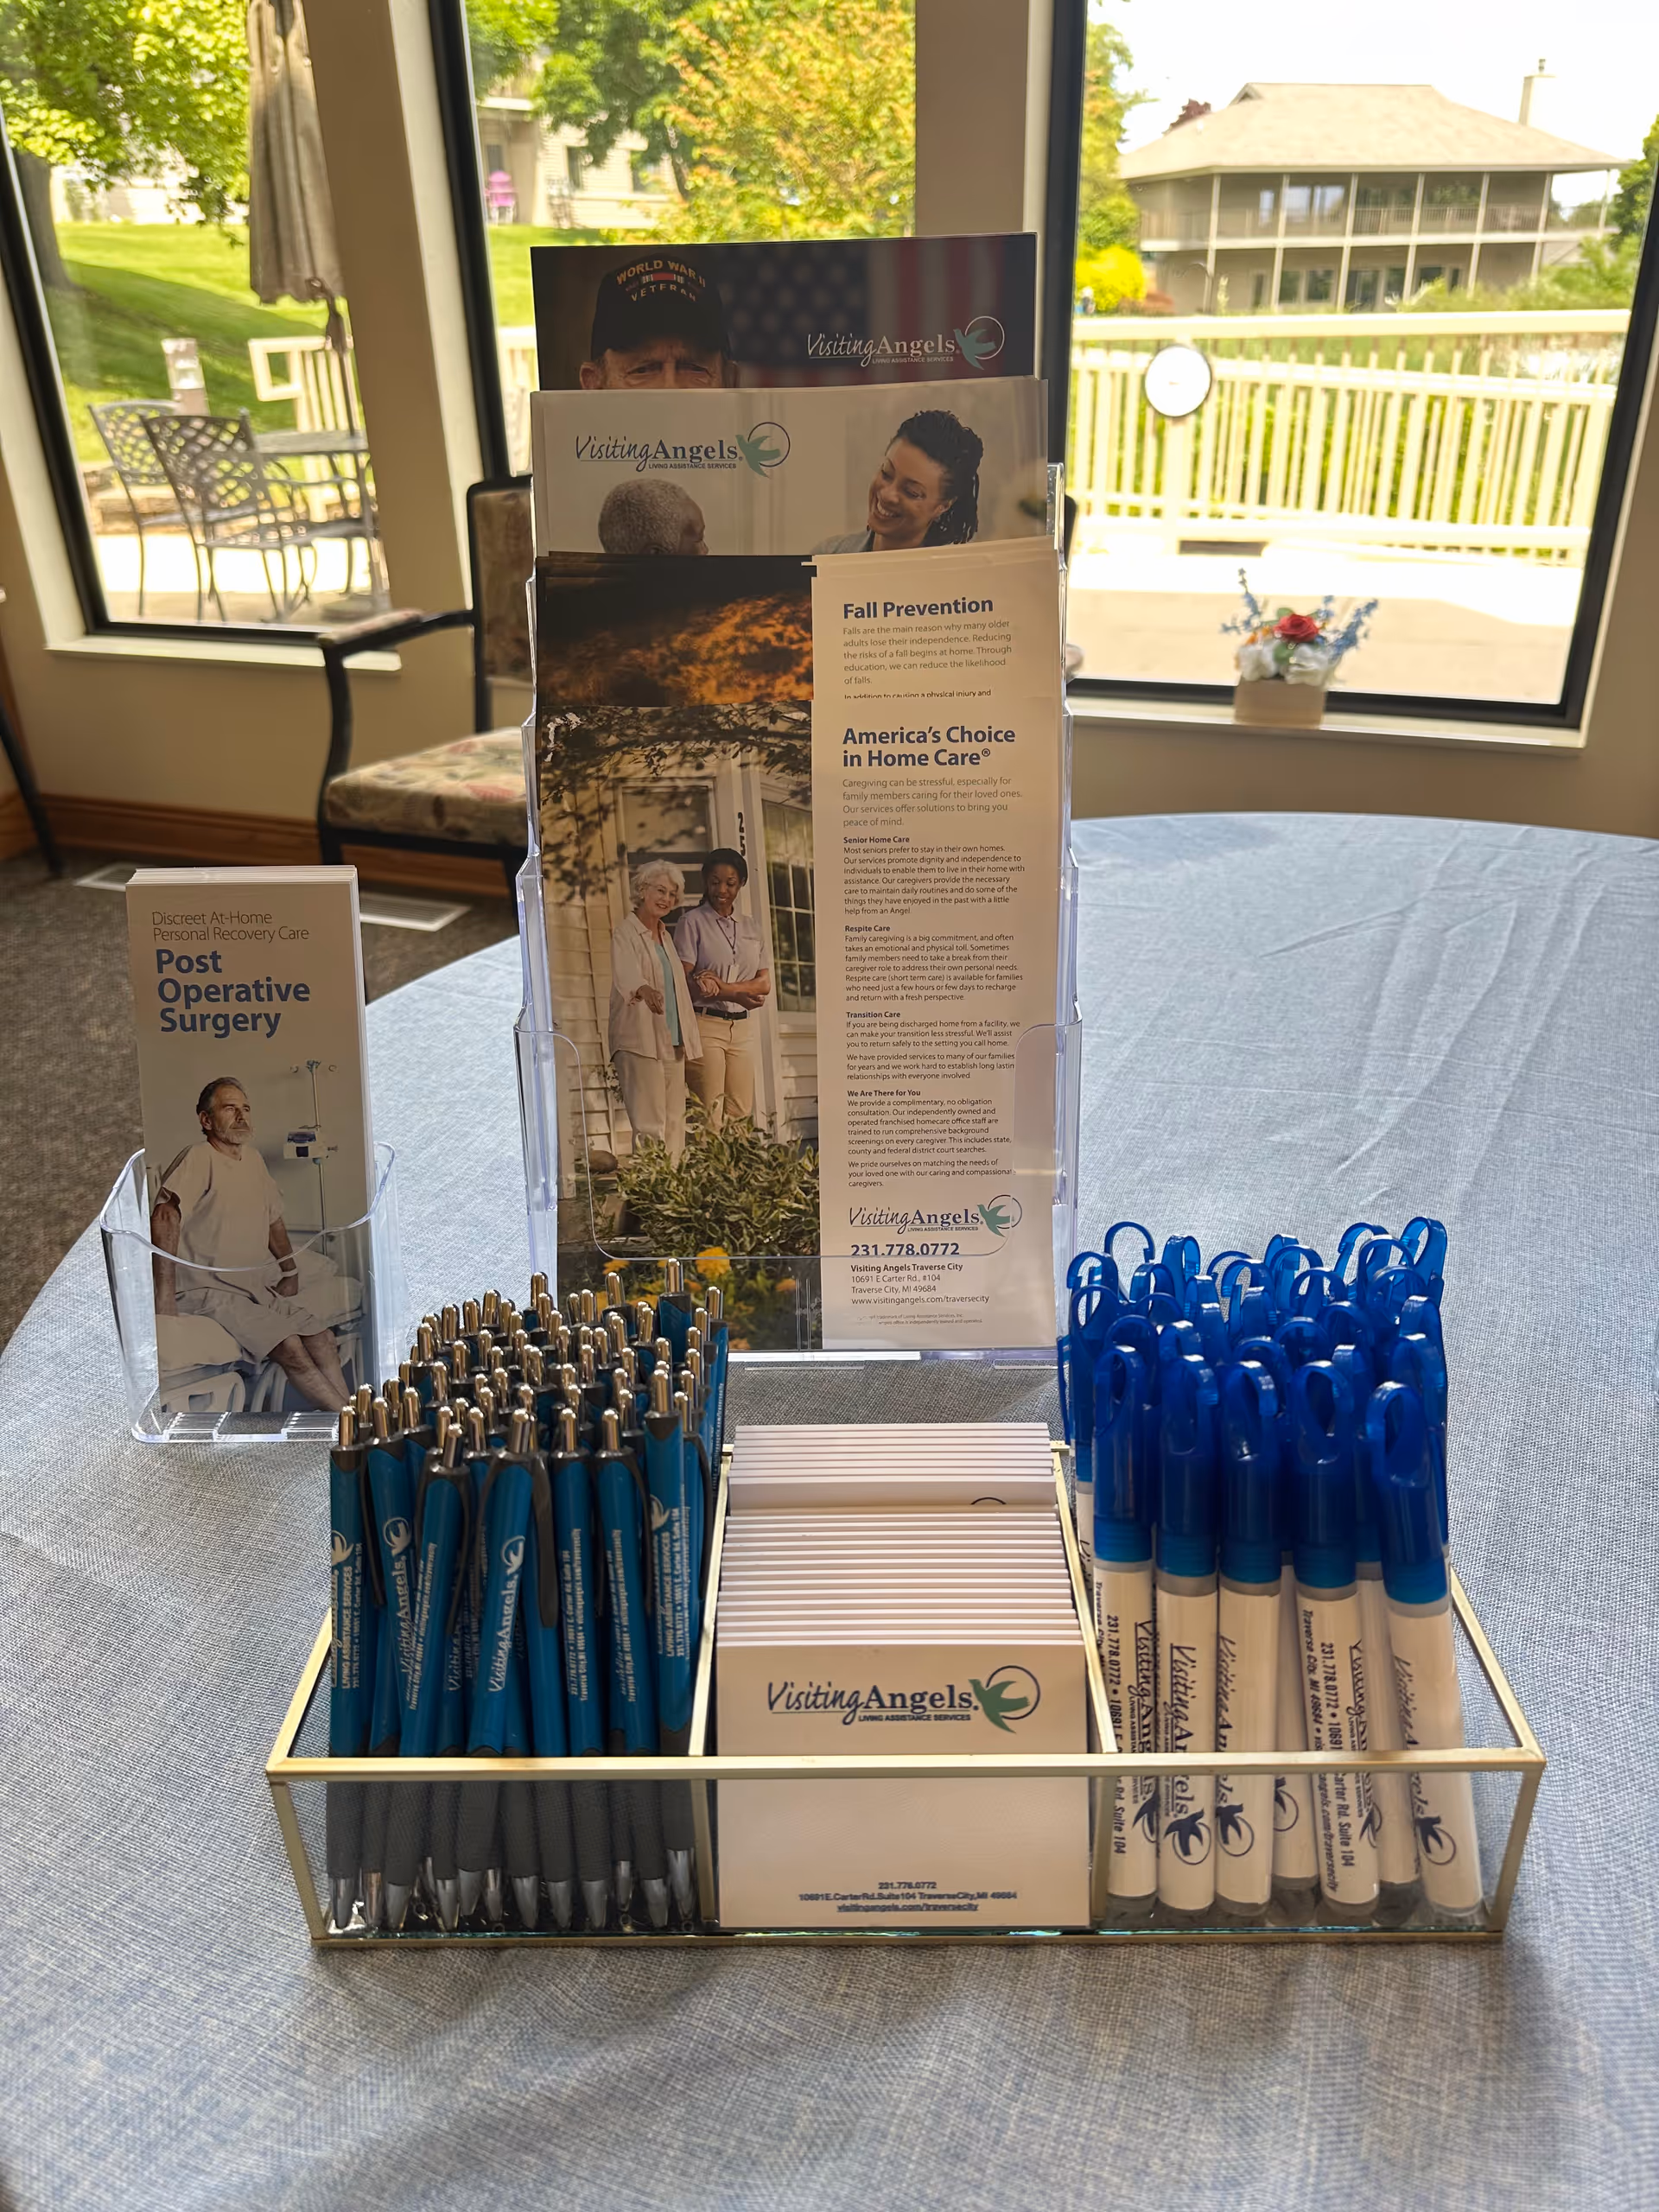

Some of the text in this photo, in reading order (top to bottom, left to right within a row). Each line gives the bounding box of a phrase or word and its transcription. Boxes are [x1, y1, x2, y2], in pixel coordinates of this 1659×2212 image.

[616, 260, 663, 285] WORLD
[667, 260, 696, 279] WAR
[632, 283, 696, 302] VETERAN
[843, 597, 993, 619] Fall Prevention
[842, 626, 861, 634] Falls
[876, 625, 891, 633] the
[893, 624, 913, 632] main
[943, 621, 962, 632] why
[963, 623, 986, 632] many
[988, 620, 1011, 628] older
[843, 637, 868, 646] adults
[869, 637, 887, 645] lose
[887, 636, 907, 645] their
[972, 632, 1013, 645] Reducing
[843, 650, 857, 658] the
[877, 649, 887, 658] of
[908, 647, 937, 658] begins
[976, 645, 1014, 656] Through
[842, 661, 887, 672] education,
[919, 659, 948, 668] reduce
[950, 659, 963, 668] the
[965, 658, 1007, 667] likelihood
[842, 673, 872, 683] of falls.
[842, 726, 1015, 744] America's Choice
[843, 750, 861, 766] in
[868, 750, 929, 766] Home
[842, 778, 887, 789] Caregiving
[905, 777, 918, 785] be
[918, 777, 955, 788] stressful,
[957, 776, 998, 787] especially
[998, 776, 1012, 785] for
[879, 817, 904, 825] mind.
[152, 911, 273, 925] Discreet At-Home
[843, 907, 861, 916] help
[153, 926, 309, 944] Personal Recovery Care
[843, 924, 872, 933] Respite
[156, 949, 222, 974] Post
[158, 976, 310, 1009] Operative
[160, 1007, 281, 1038] Surgery
[847, 1147, 871, 1155] county
[851, 1243, 960, 1255] 231.778.0772
[851, 1264, 881, 1273] Visiting
[883, 1264, 911, 1273] Angels
[884, 1286, 900, 1294] City,
[851, 1295, 989, 1305] www.visitingangels.com/traversecity
[661, 1532, 675, 1657] LIVING ASSISTANCE SERVICES
[342, 1566, 353, 1688] LIVING ASSISTANCE SERVICES
[1303, 1609, 1319, 1652] Traverse
[1107, 1614, 1122, 1685] 231.778.0772
[1321, 1642, 1339, 1708] 231.778.0772
[1307, 1678, 1321, 1692] MI
[1329, 1722, 1342, 1750] 10691
[1114, 1806, 1124, 1834] Suite
[1337, 1803, 1350, 1820] Rd.
[1338, 1821, 1352, 1847] Suite
[1114, 1836, 1126, 1853] 104
[1340, 1849, 1356, 1866] 104
